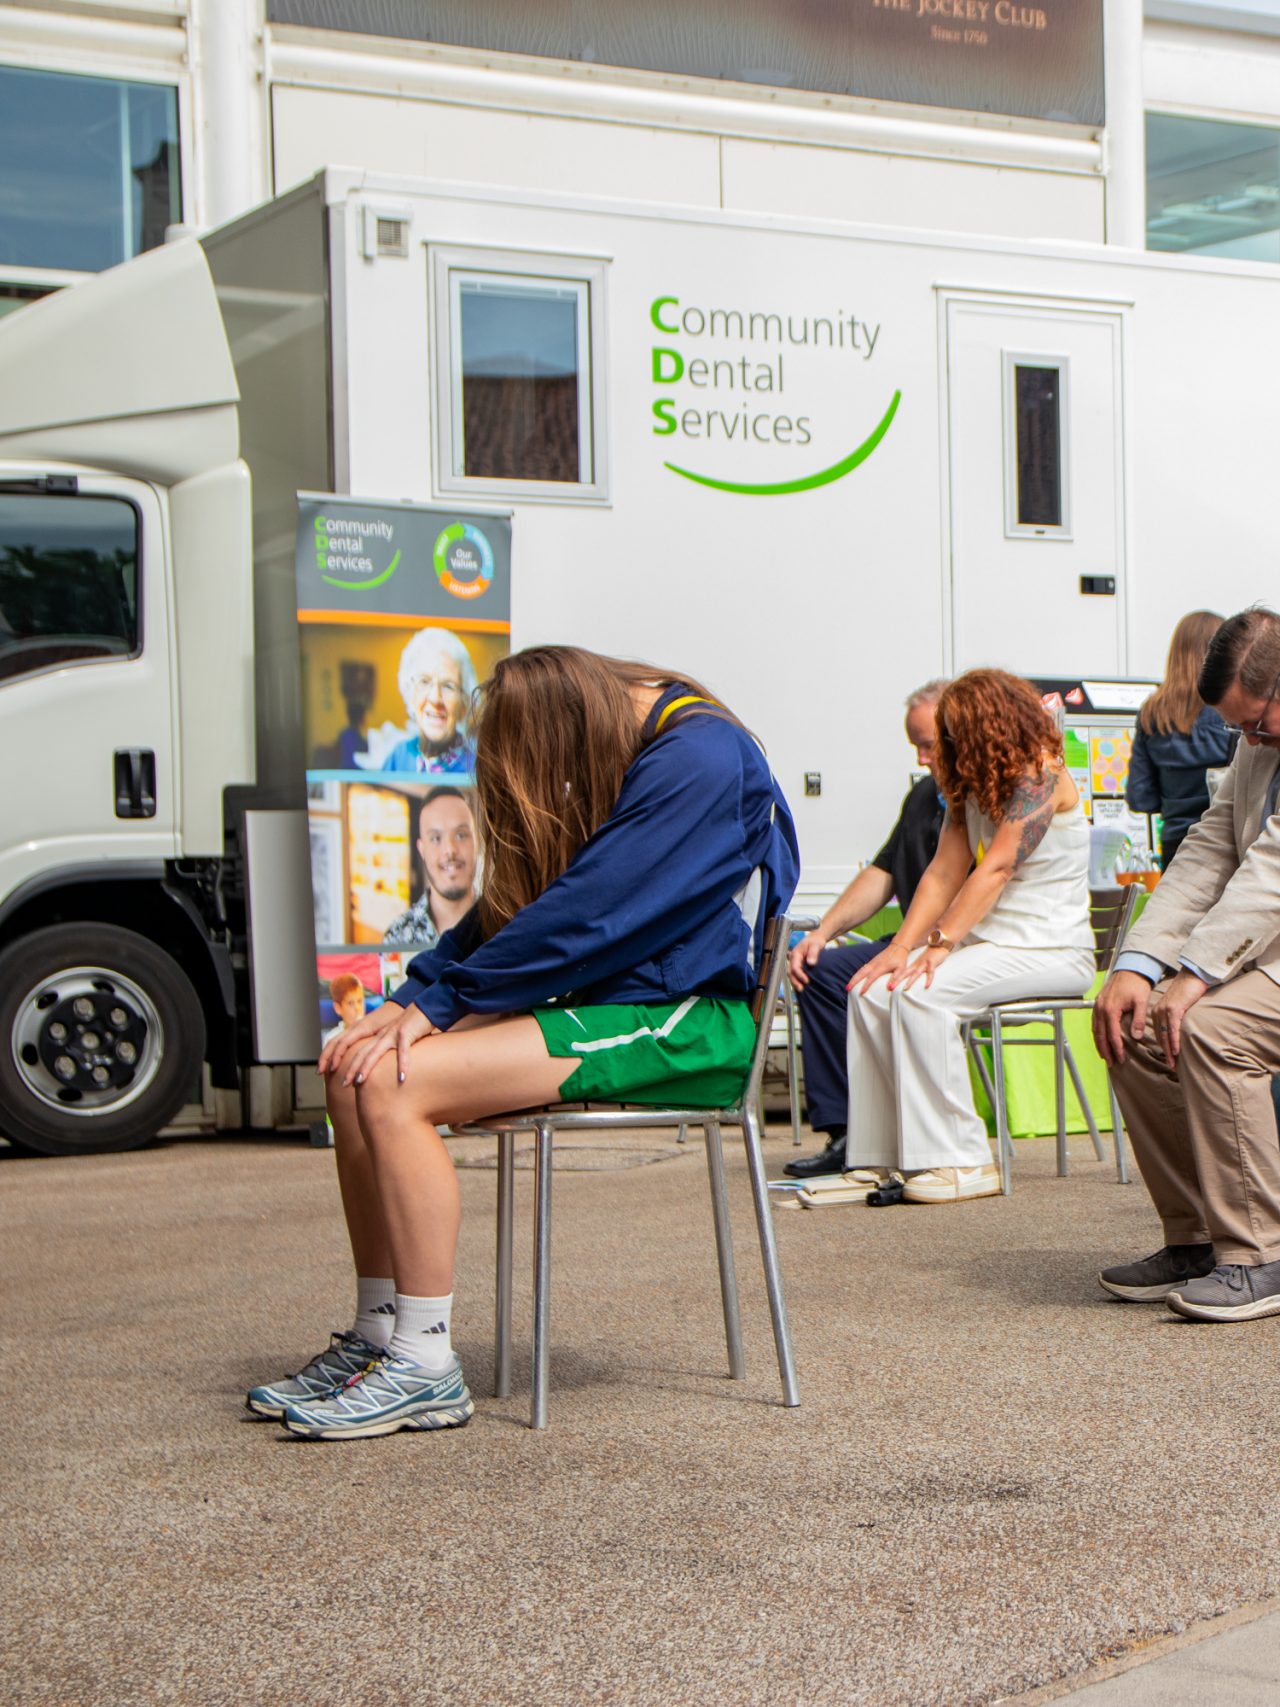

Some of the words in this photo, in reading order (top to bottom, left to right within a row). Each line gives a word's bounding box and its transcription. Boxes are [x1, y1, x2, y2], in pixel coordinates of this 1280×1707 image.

[916, 0, 991, 22] JOCKEY
[994, 1, 1048, 31] CLUB
[649, 295, 881, 361] Community
[651, 346, 784, 393] Dental
[651, 397, 812, 446] Services
[314, 516, 394, 542] Community
[315, 534, 363, 552] Dental
[456, 547, 472, 559] Our
[316, 552, 373, 573] Services
[450, 556, 478, 571] Values
